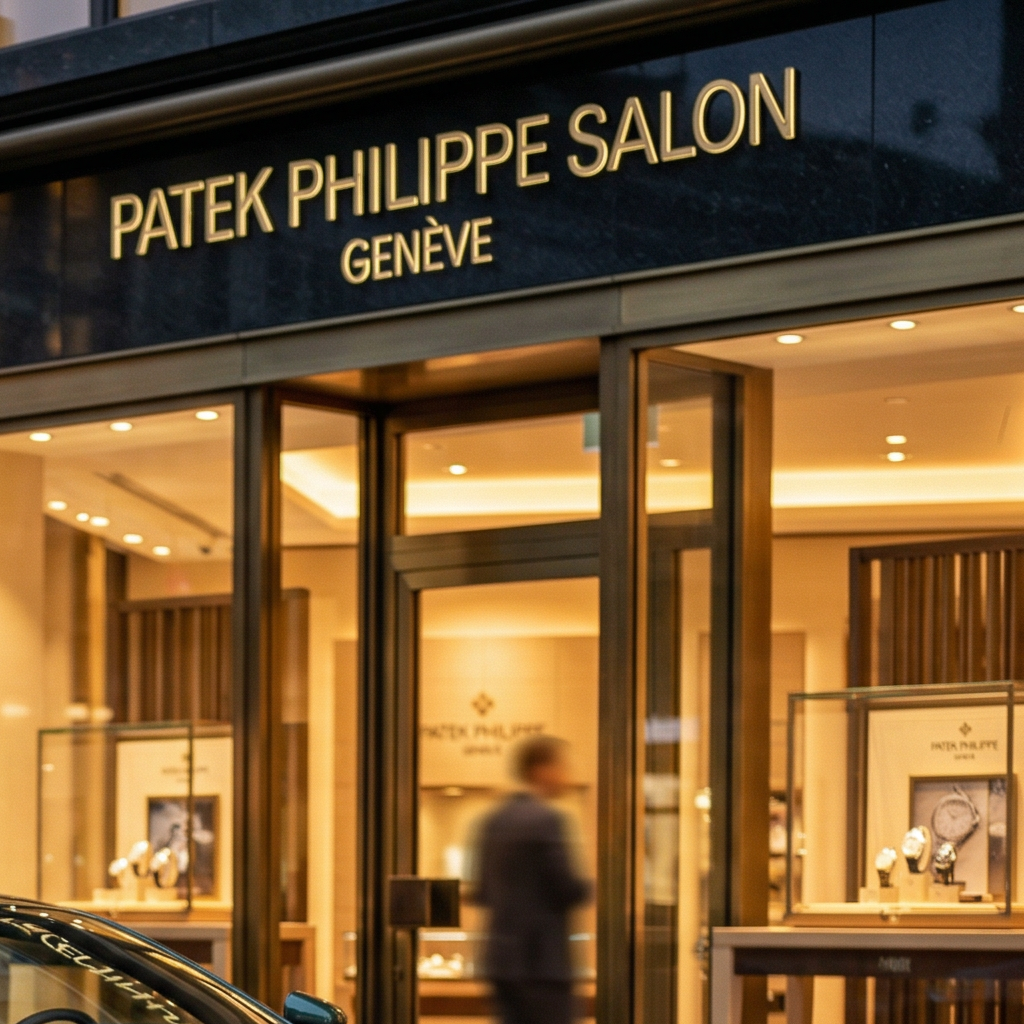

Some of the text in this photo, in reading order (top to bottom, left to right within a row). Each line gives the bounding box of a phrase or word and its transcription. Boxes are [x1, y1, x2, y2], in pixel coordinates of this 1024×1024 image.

[110, 67, 796, 260] PATEK PHILIPPE SALON
[340, 216, 494, 284] GENÈVE
